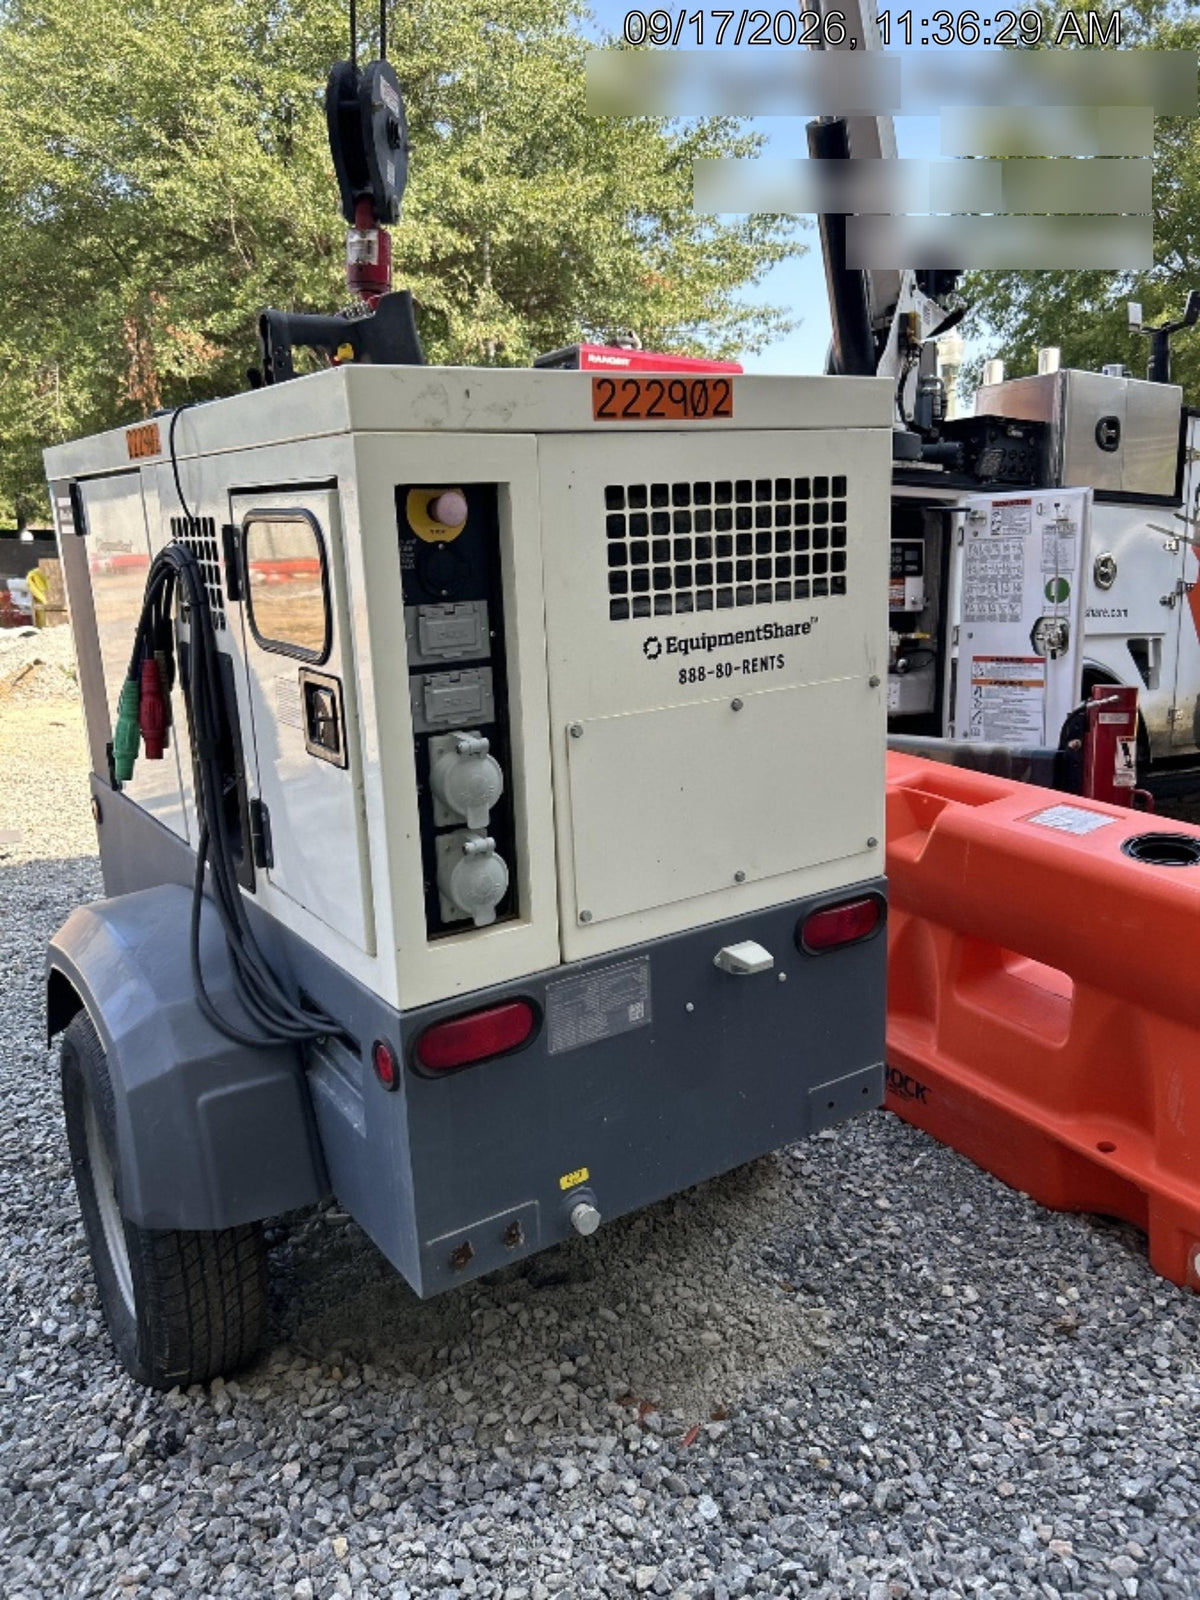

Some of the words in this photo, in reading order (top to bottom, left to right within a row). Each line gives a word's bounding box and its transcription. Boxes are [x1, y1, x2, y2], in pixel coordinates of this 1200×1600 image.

[596, 378, 731, 418] 222902
[678, 653, 785, 685] 888-80-RENTS
[885, 1064, 933, 1104] OCK
